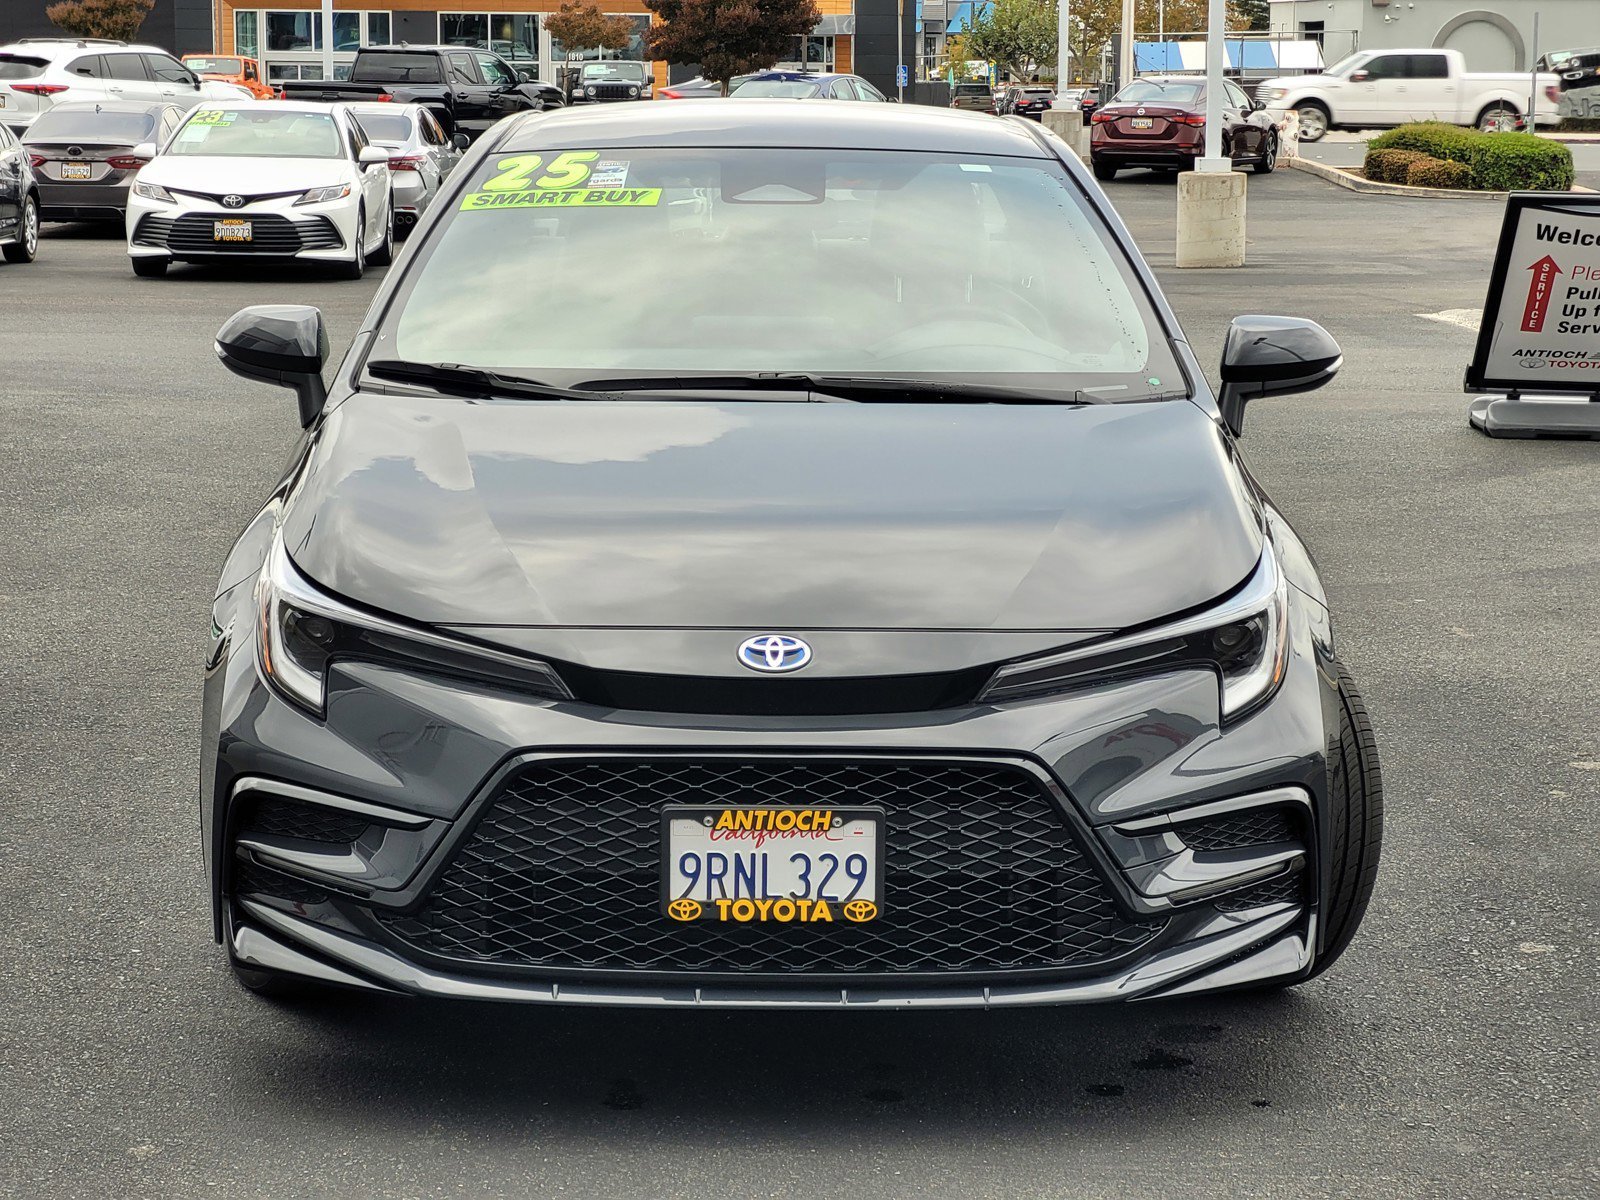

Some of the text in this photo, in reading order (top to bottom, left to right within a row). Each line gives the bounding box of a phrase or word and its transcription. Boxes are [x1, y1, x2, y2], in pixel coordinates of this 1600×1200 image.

[568, 52, 584, 61] 1810
[190, 110, 225, 123] 23
[482, 151, 600, 191] 25
[472, 189, 653, 207] SMART BUY
[1528, 263, 1550, 328] SERVICE
[1562, 304, 1587, 319] Up
[1511, 349, 1588, 359] ANTIOCH
[715, 810, 833, 832] ANTIOCH
[678, 852, 868, 900] 9RNL329
[715, 898, 833, 922] TOYOTA
